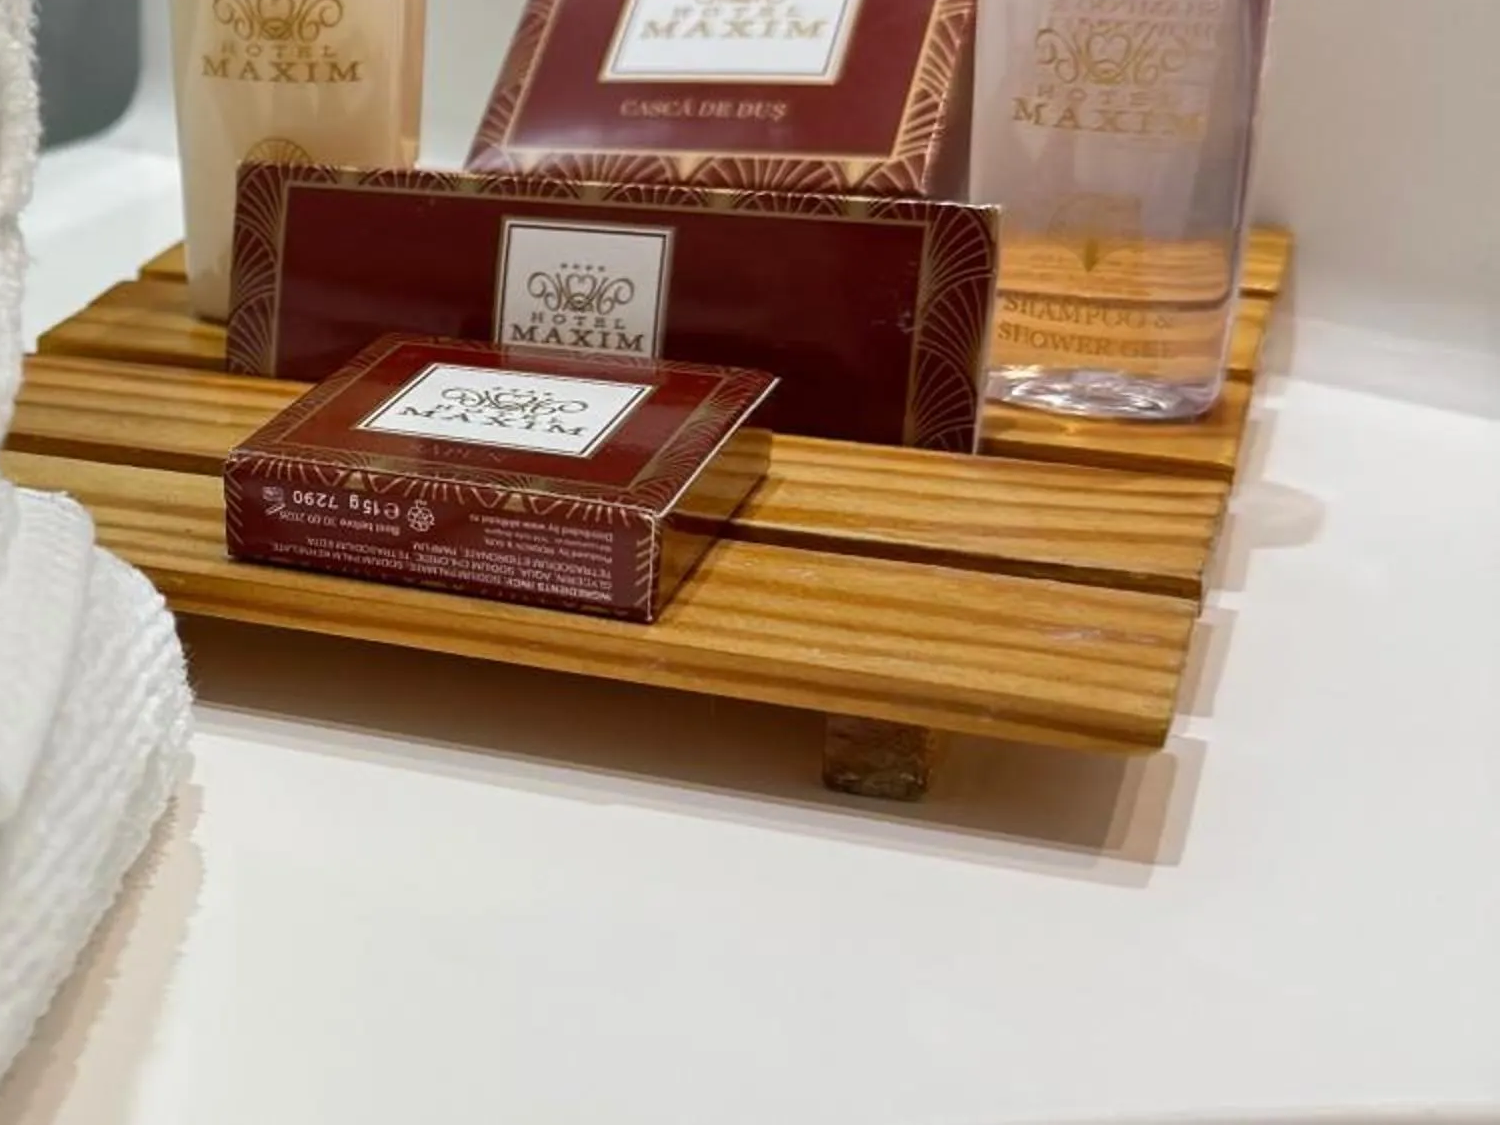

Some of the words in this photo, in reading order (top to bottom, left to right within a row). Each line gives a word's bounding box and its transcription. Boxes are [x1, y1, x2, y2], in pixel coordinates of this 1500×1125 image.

[640, 20, 828, 40] MAXIM
[221, 40, 338, 59] HOTEL
[202, 55, 363, 83] MAXIM
[698, 100, 733, 117] DE
[530, 312, 627, 330] HOTEL
[1003, 294, 1146, 329] SHAMPOO
[510, 324, 645, 352] MAXIM
[998, 321, 1113, 357] SHOWER
[398, 406, 589, 436] MAXIM
[292, 488, 338, 509] 7290
[349, 493, 359, 510] g
[362, 498, 380, 516] 15
